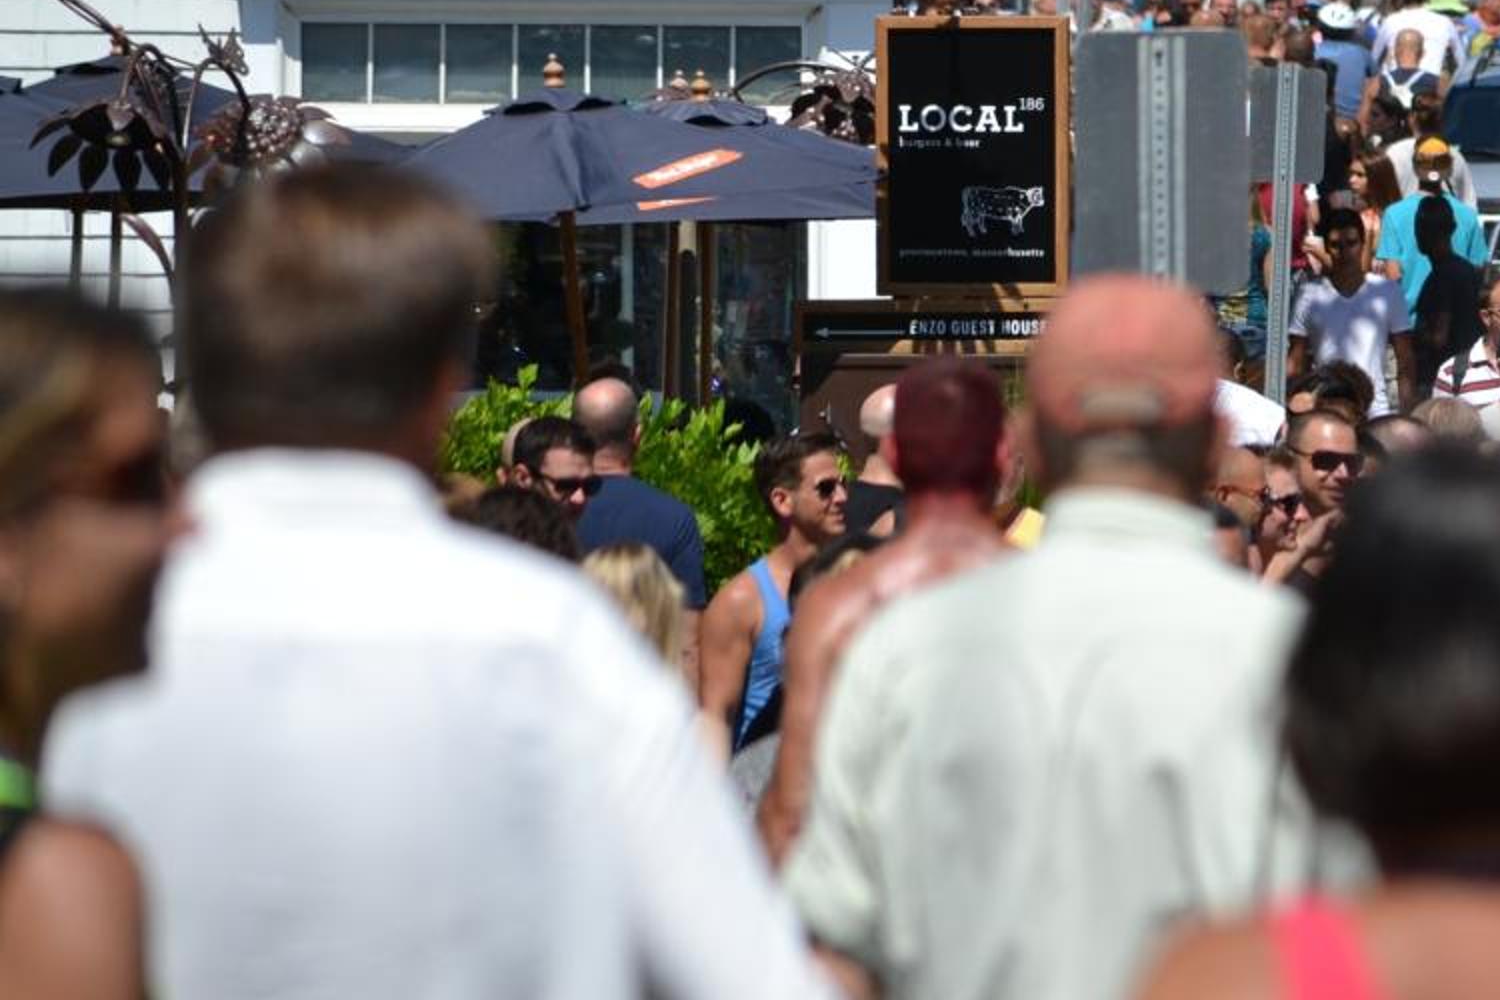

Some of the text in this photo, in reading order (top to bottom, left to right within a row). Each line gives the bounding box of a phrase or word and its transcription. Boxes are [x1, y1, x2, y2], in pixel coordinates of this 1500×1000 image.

[898, 97, 1045, 132] LOCAL 186
[909, 319, 946, 335] ENZO
[951, 319, 996, 335] GUEST
